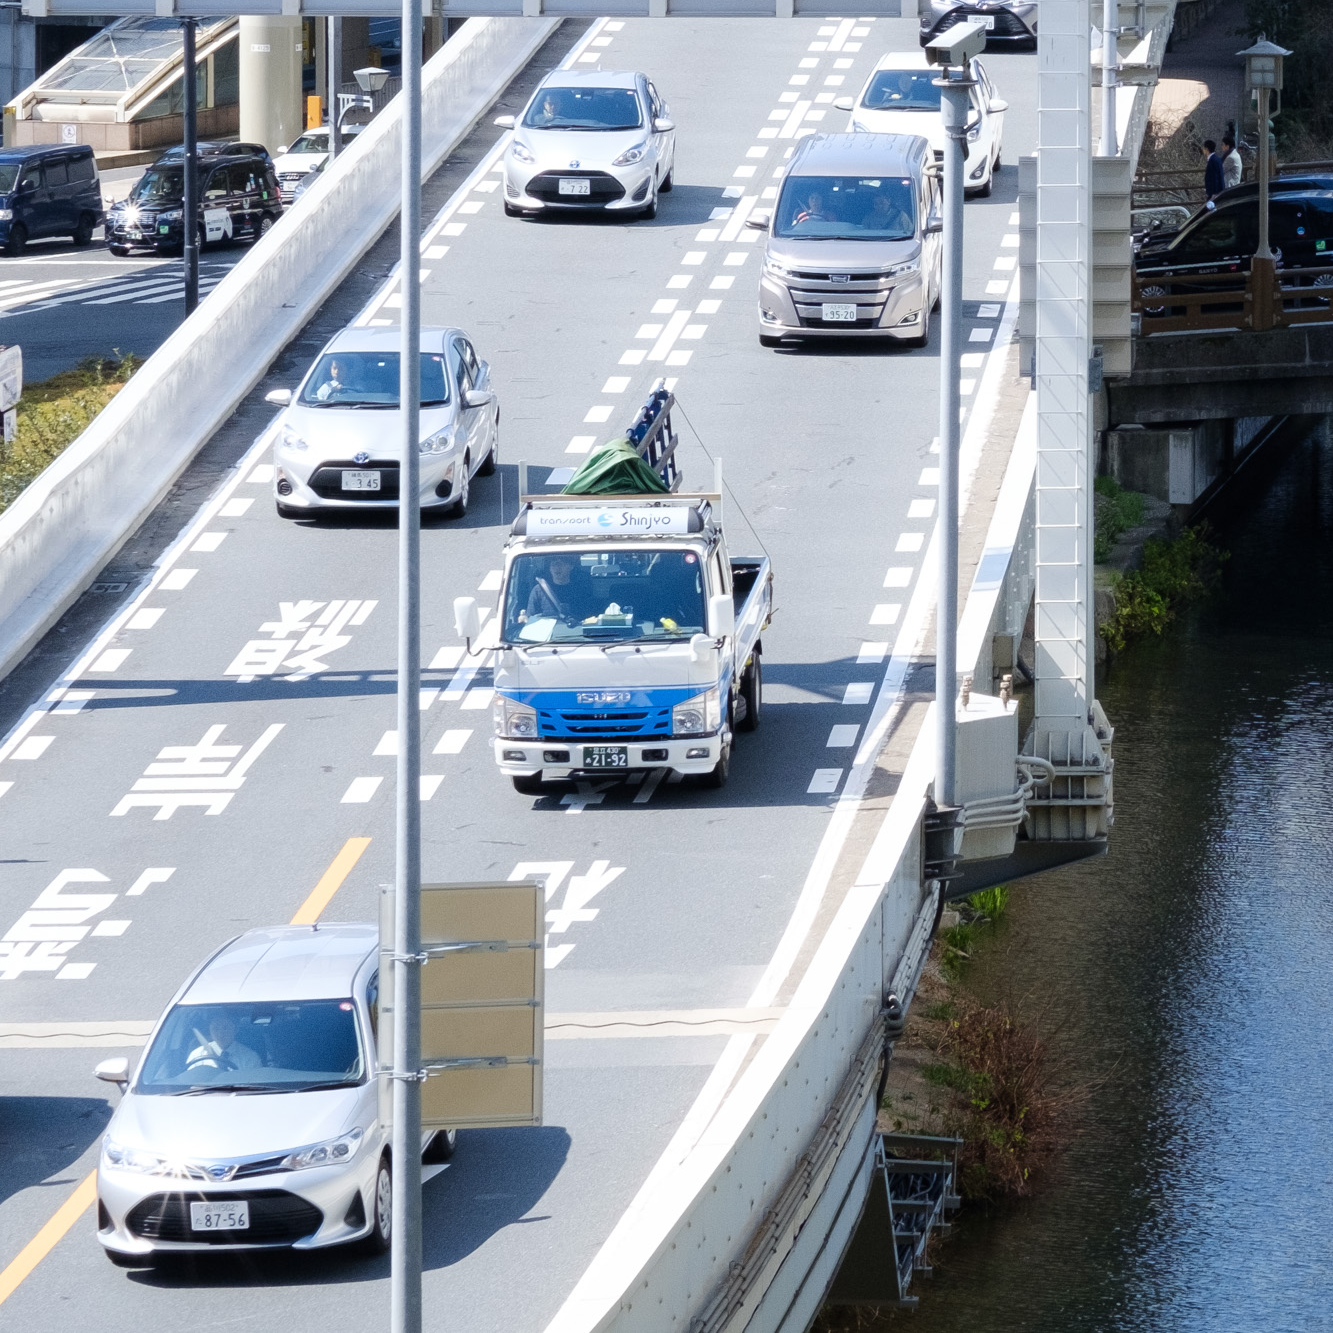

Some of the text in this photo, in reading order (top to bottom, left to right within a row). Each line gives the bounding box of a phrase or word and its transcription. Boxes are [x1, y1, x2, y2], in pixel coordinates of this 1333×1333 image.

[829, 310, 855, 320] 95-20
[620, 511, 671, 530] Shinjyo
[576, 692, 631, 704] ISUZU
[592, 754, 626, 767] 21-92
[204, 1212, 246, 1228] 87-56
